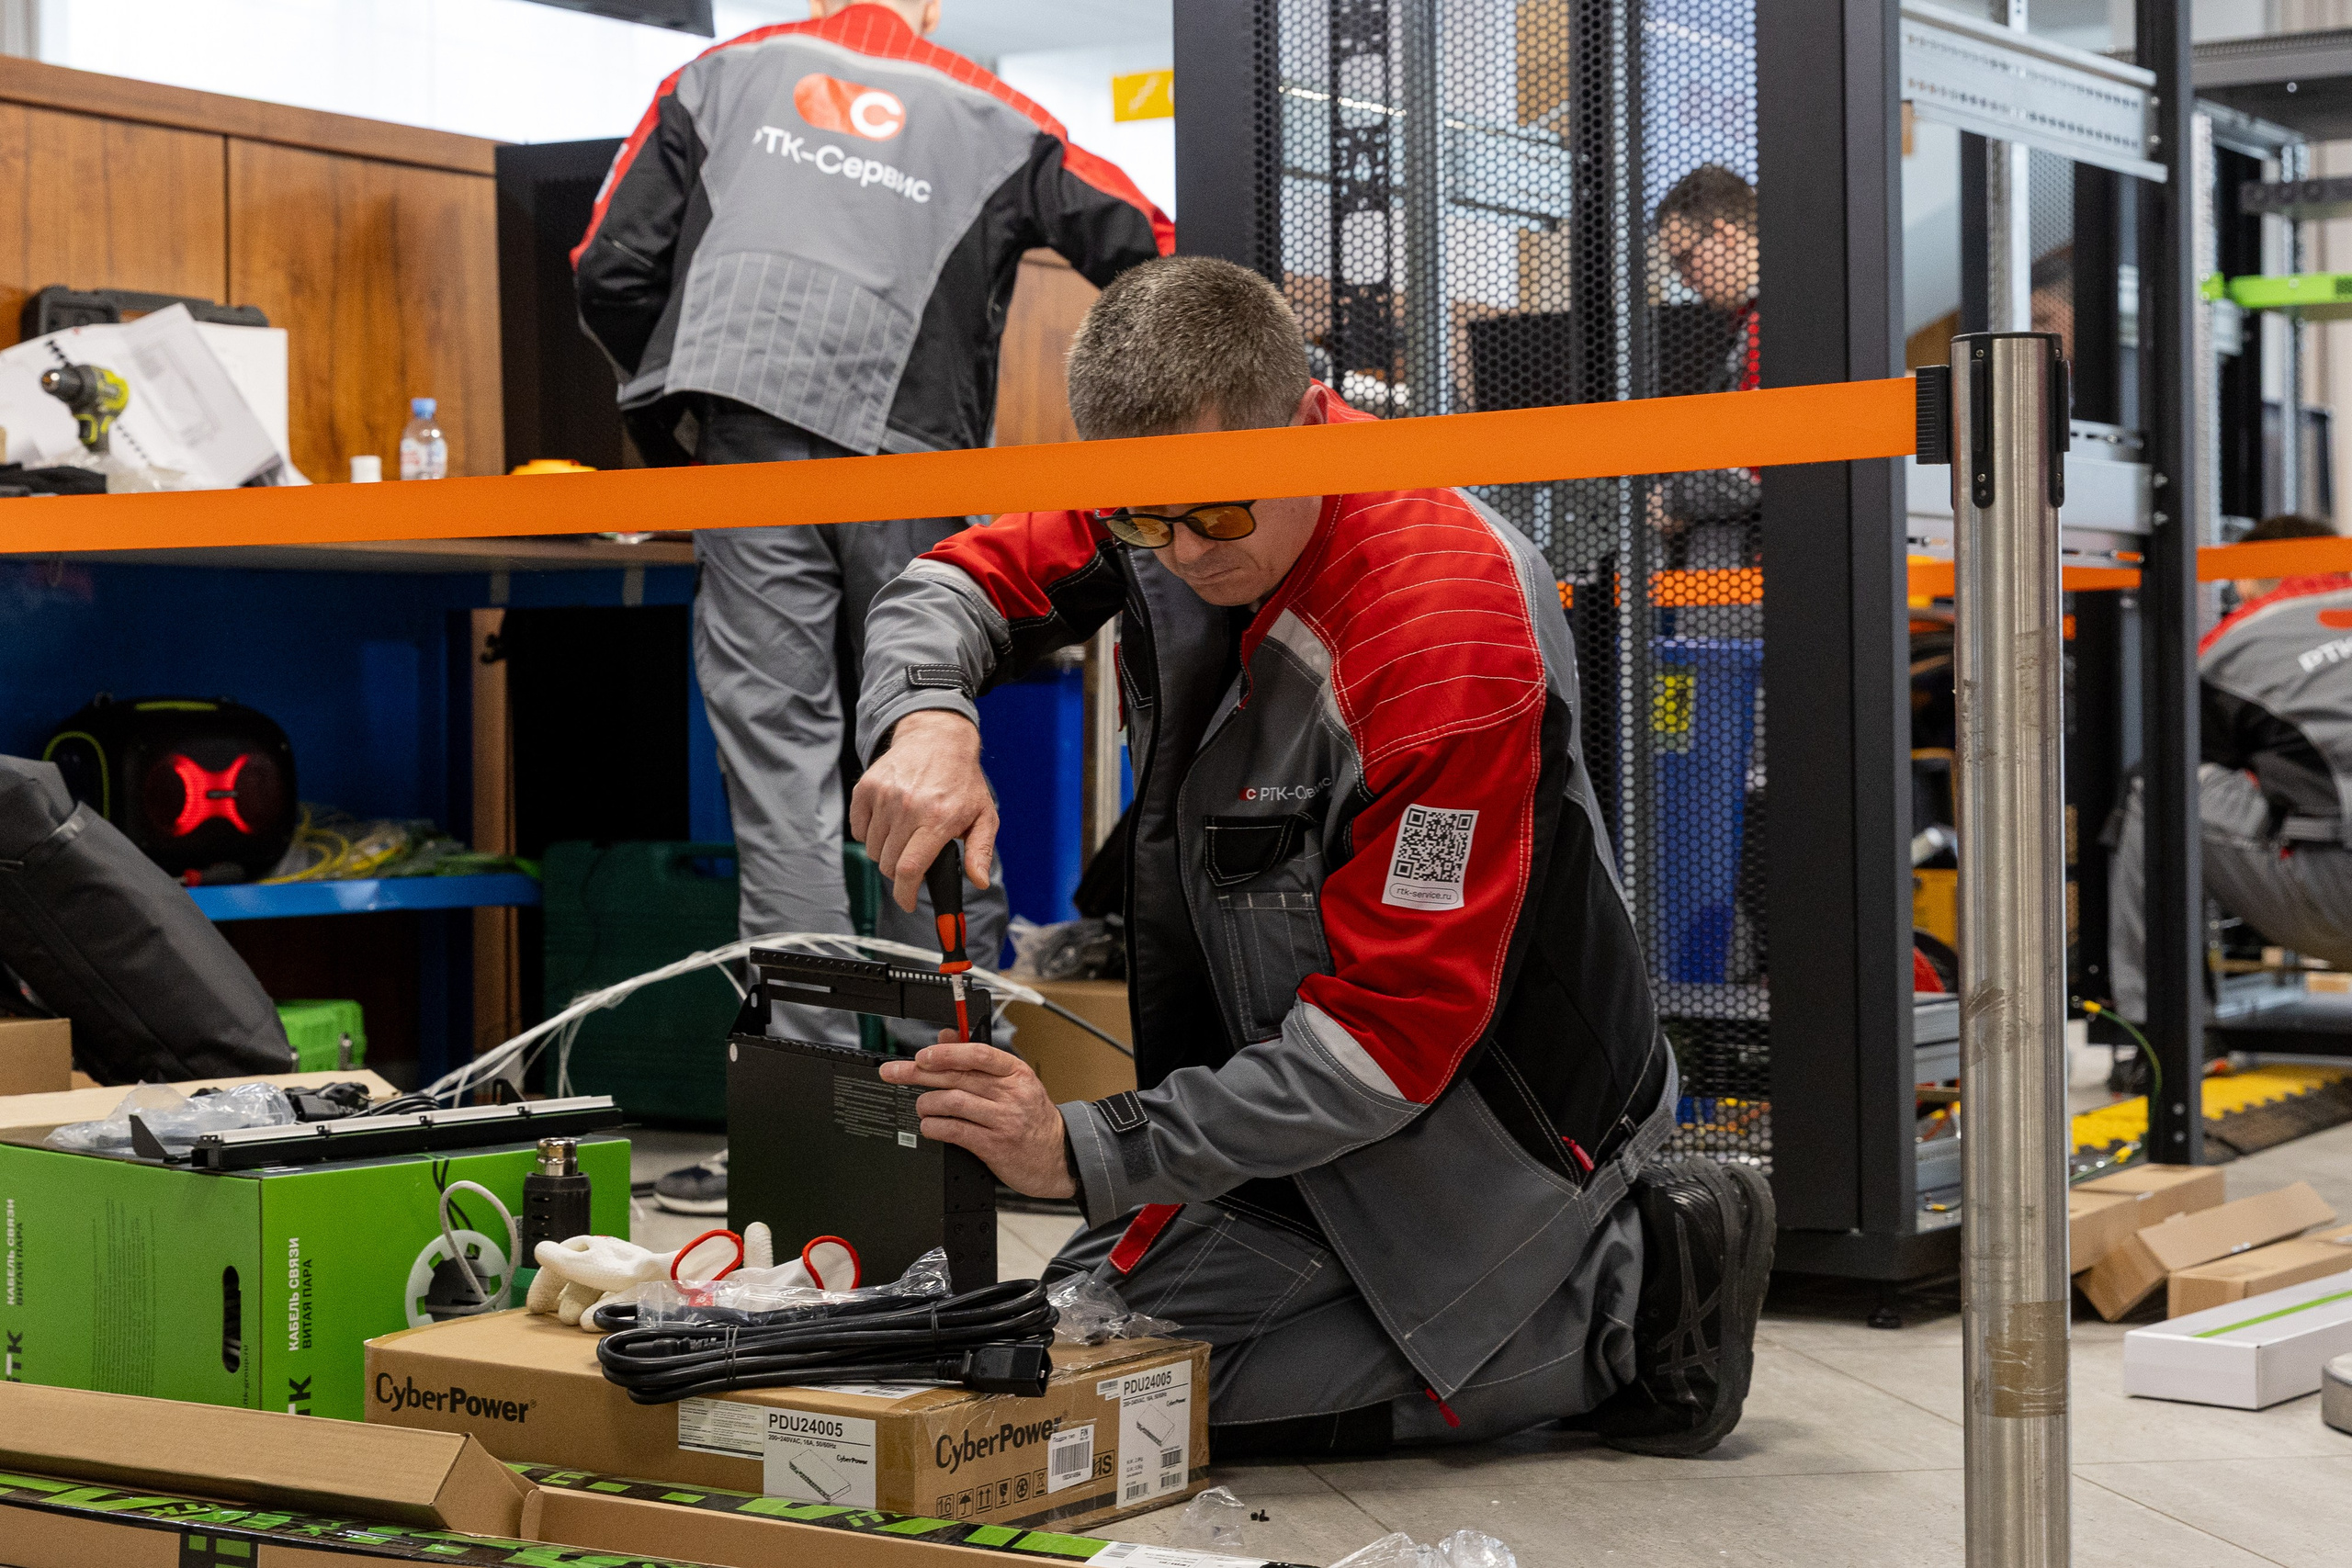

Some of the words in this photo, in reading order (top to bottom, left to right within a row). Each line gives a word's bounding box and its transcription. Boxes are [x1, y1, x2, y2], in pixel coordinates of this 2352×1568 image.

[752, 125, 933, 203] ТК-Сервис
[1396, 887, 1452, 900] rtk-service.ru
[6, 1199, 15, 1247] СВЯЗИ
[6, 1249, 15, 1305] КАБЕЛЬ
[288, 1237, 300, 1289] СВЯЗИ
[302, 1258, 312, 1297] ПАРА
[288, 1292, 300, 1351] КАБЕЛЬ
[302, 1303, 312, 1349] ВИТАЯ
[376, 1372, 529, 1424] CyberPower
[1124, 1371, 1172, 1395] PDU24005
[768, 1413, 843, 1438] PDU24005
[938, 1497, 952, 1515] 16
